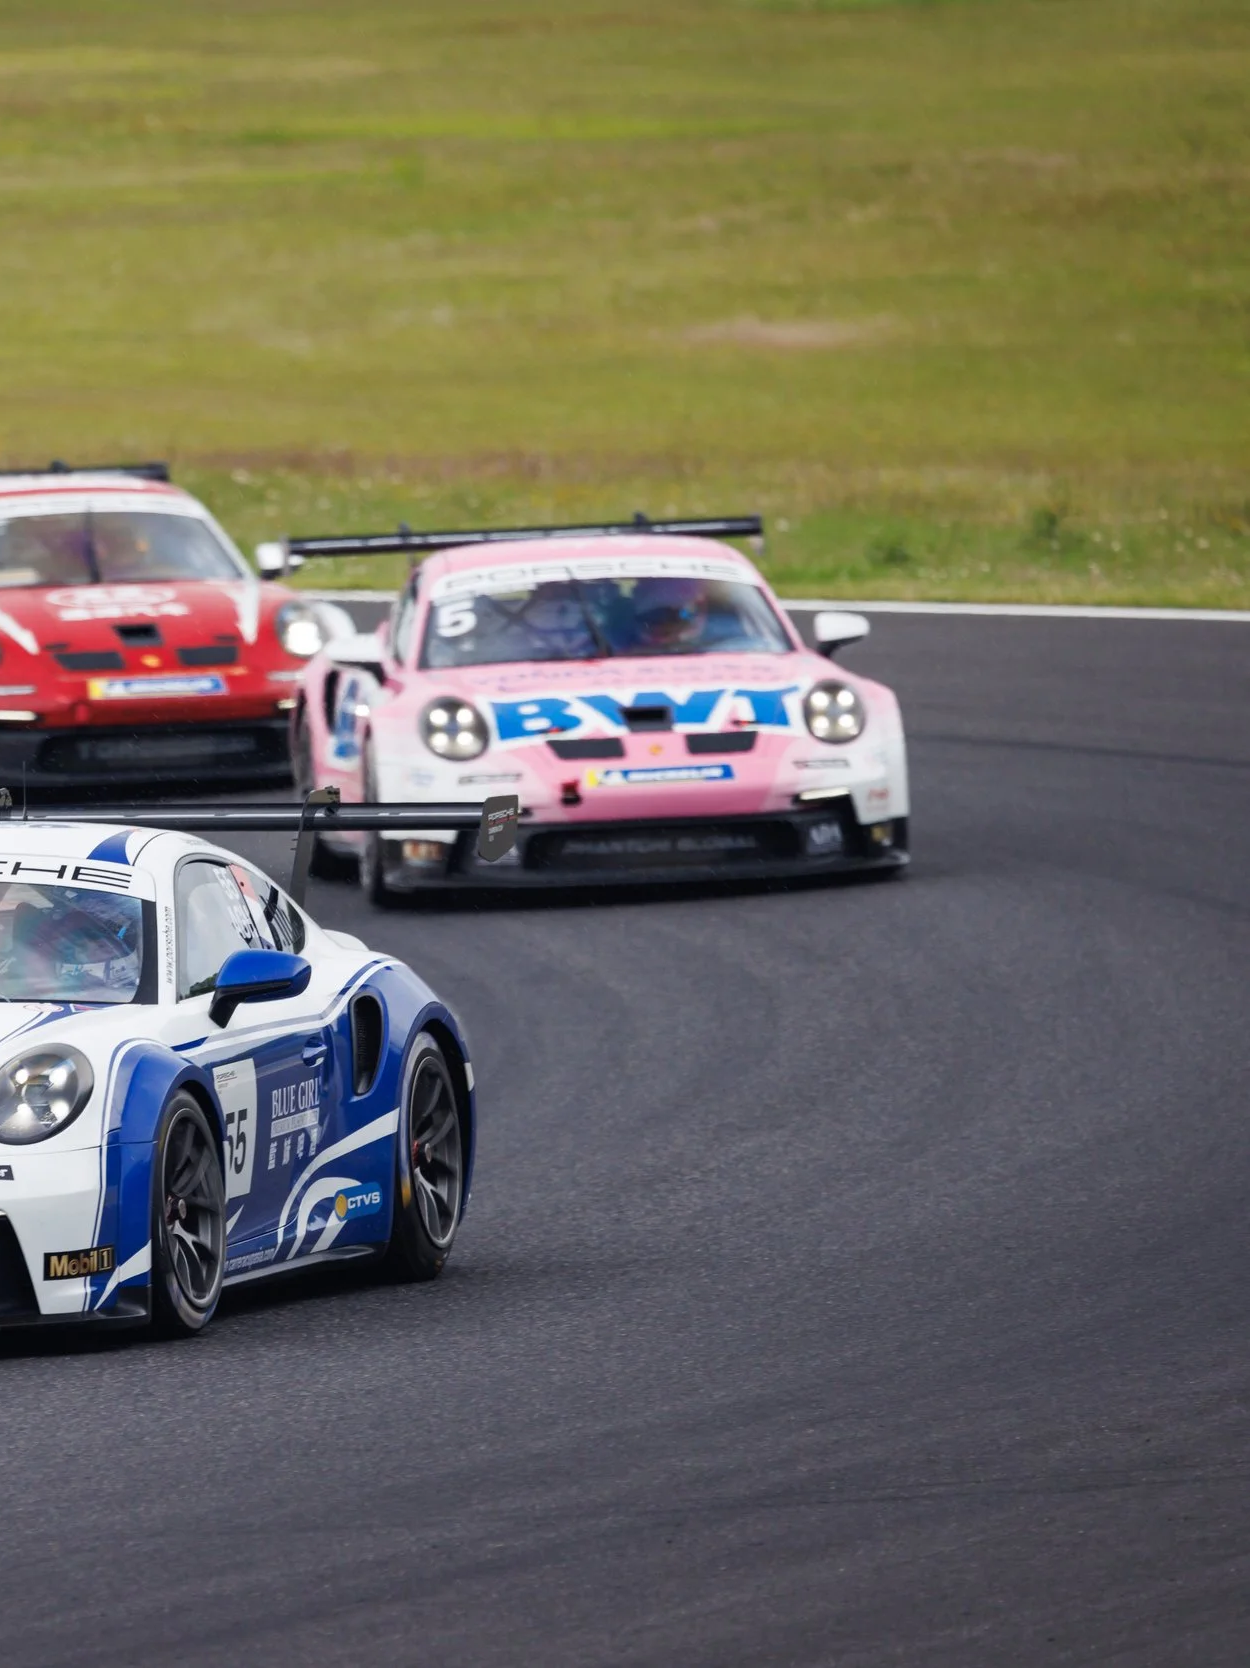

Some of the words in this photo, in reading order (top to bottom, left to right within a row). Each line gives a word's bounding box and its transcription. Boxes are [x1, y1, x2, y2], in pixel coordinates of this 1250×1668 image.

[436, 600, 477, 638] 5
[271, 1084, 296, 1119] BLUE
[297, 1077, 320, 1110] GIRL
[49, 1250, 98, 1277] Mobil
